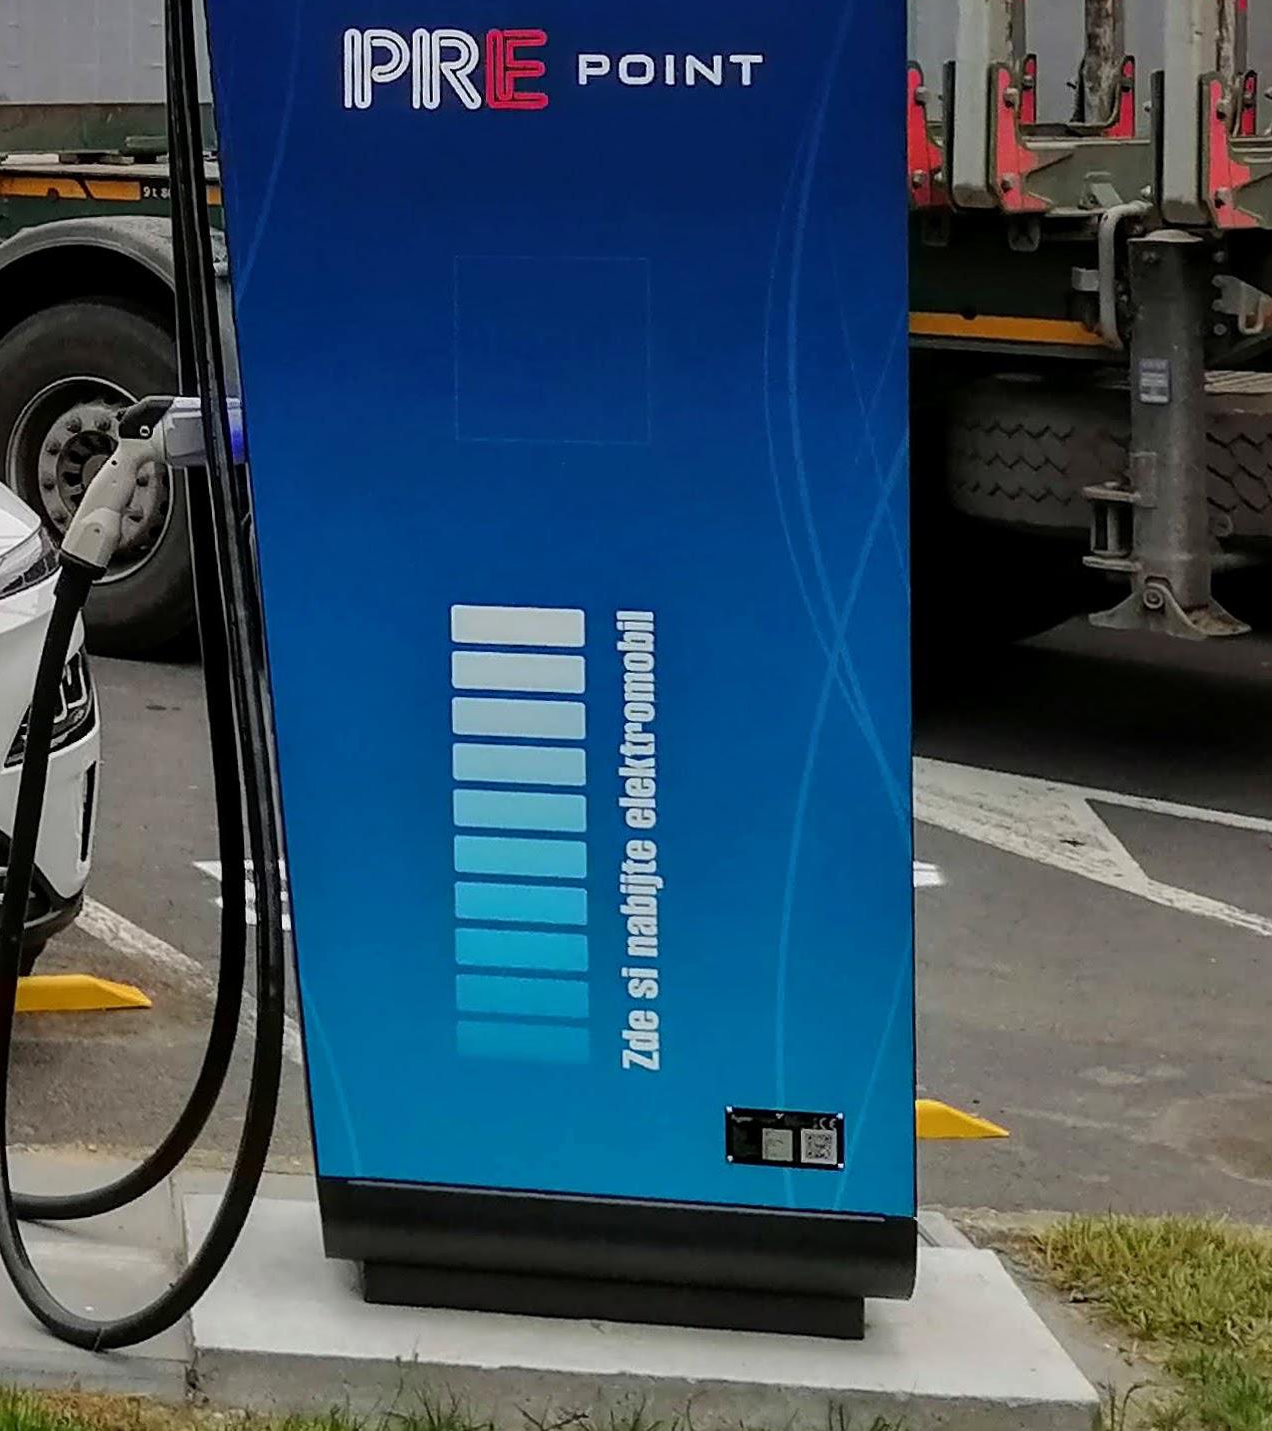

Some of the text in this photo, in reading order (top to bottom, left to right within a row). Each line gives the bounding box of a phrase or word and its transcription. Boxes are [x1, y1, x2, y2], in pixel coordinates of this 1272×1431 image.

[343, 27, 764, 110] PRE POINT
[616, 610, 665, 1071] Zde si nabijte elektromobil
